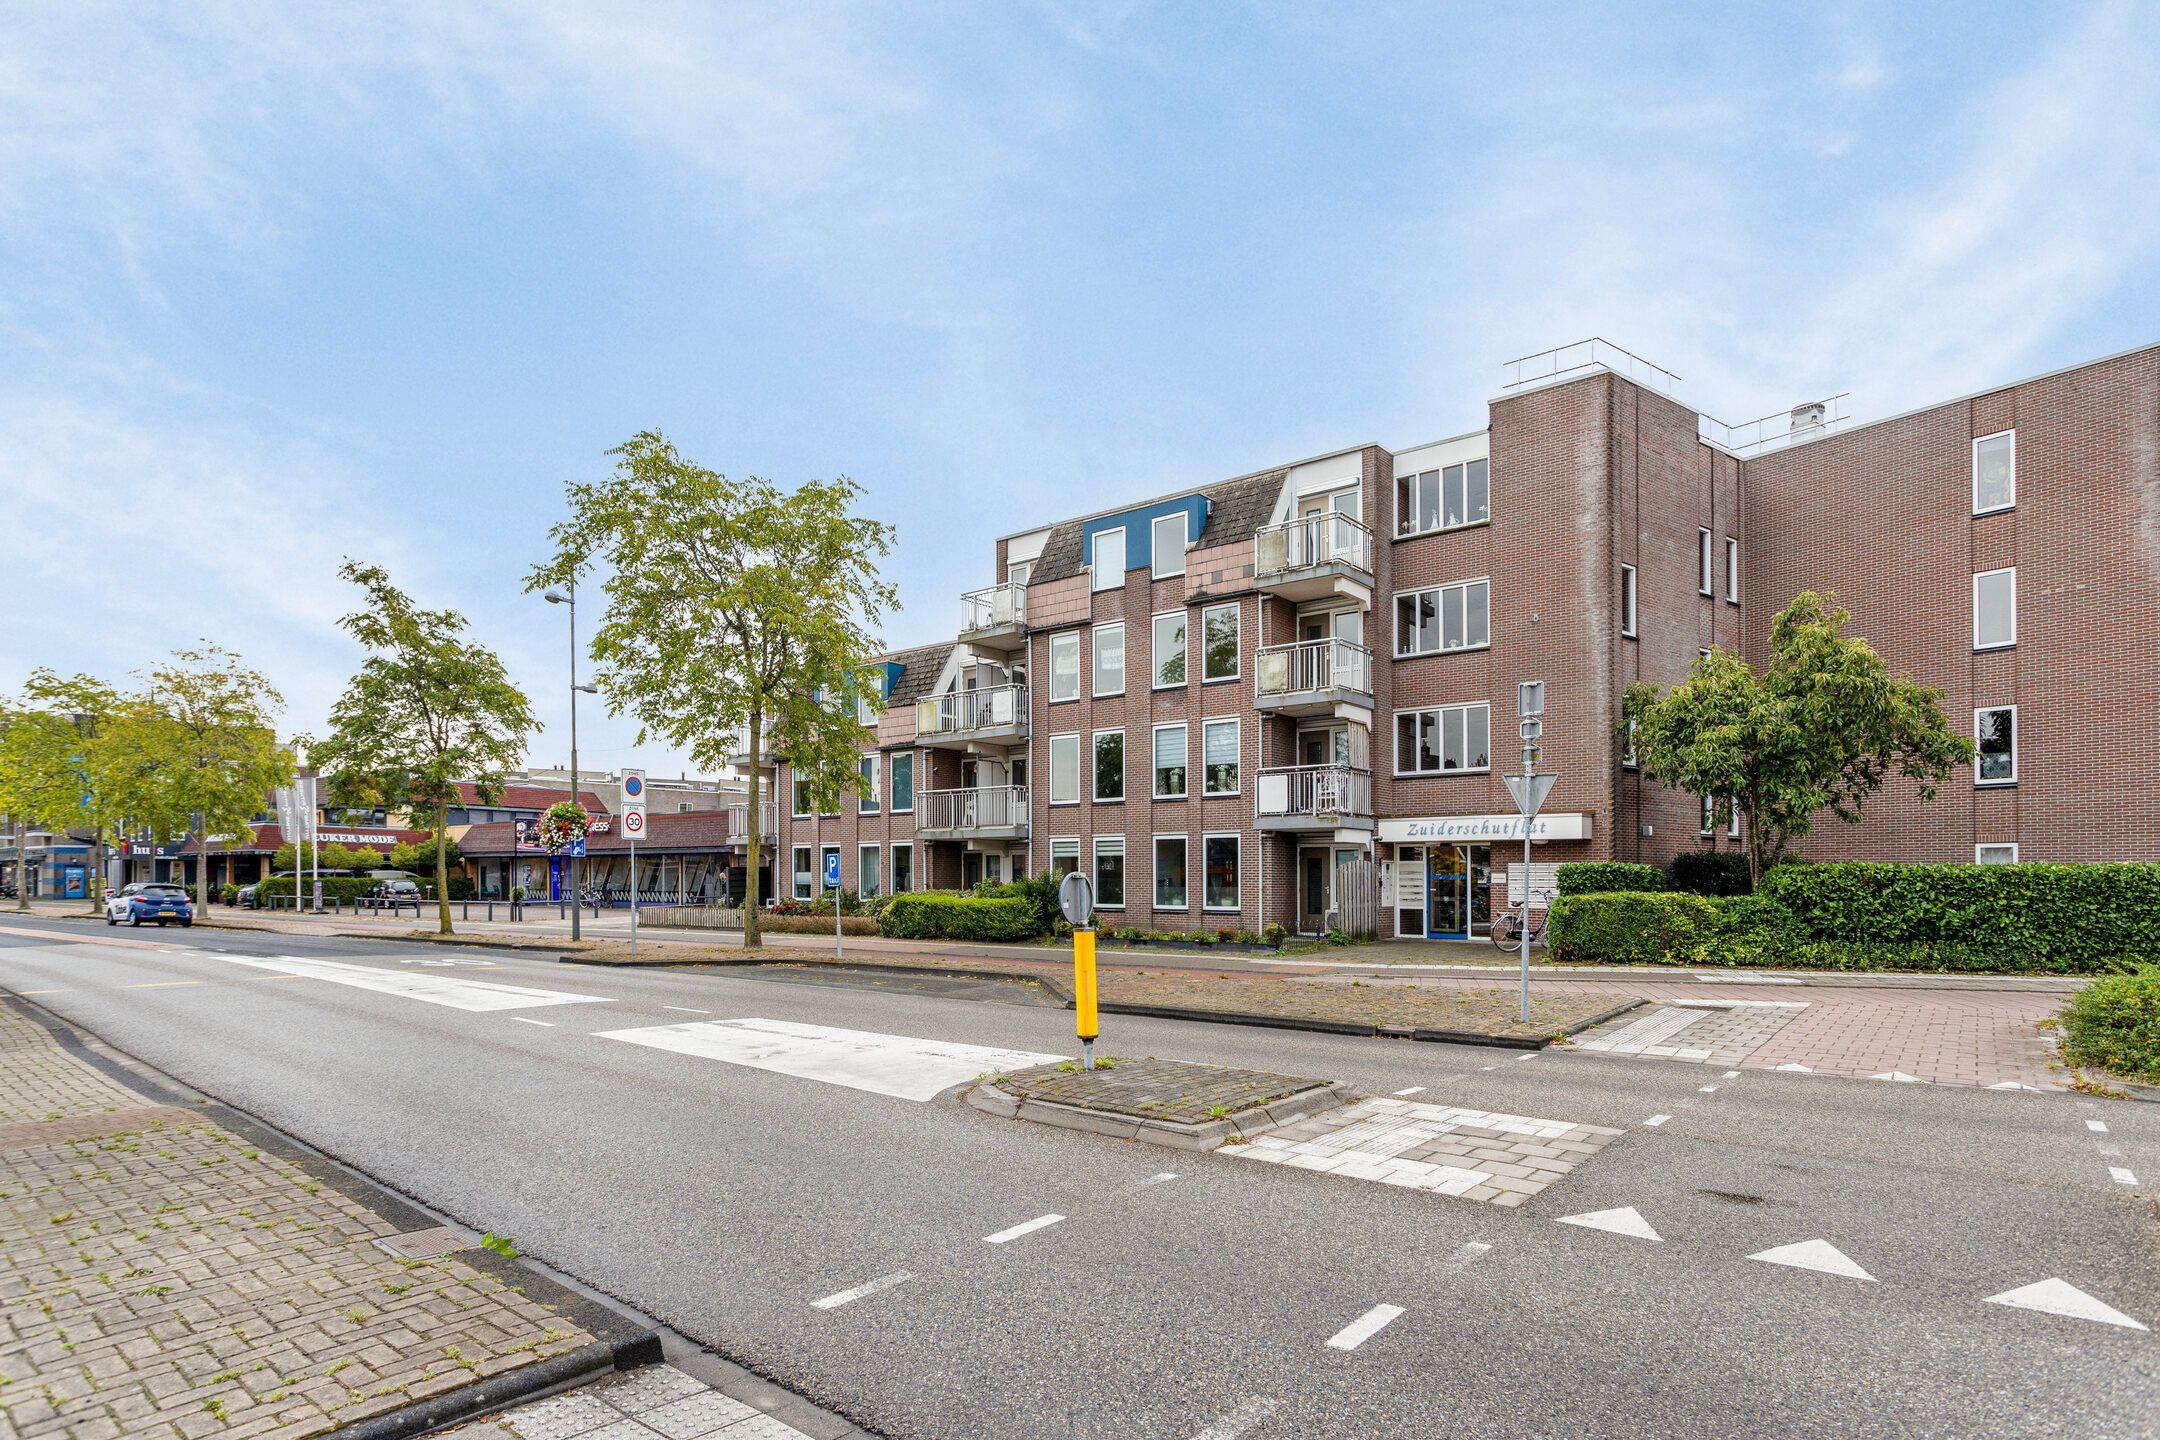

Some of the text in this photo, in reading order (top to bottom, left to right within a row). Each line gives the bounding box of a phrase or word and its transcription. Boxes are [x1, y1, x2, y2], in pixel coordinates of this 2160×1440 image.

[629, 818, 640, 826] 30
[1407, 818, 1547, 839] Zuiderschutflat
[313, 833, 397, 844] EUKER MODE
[830, 857, 836, 873] P
